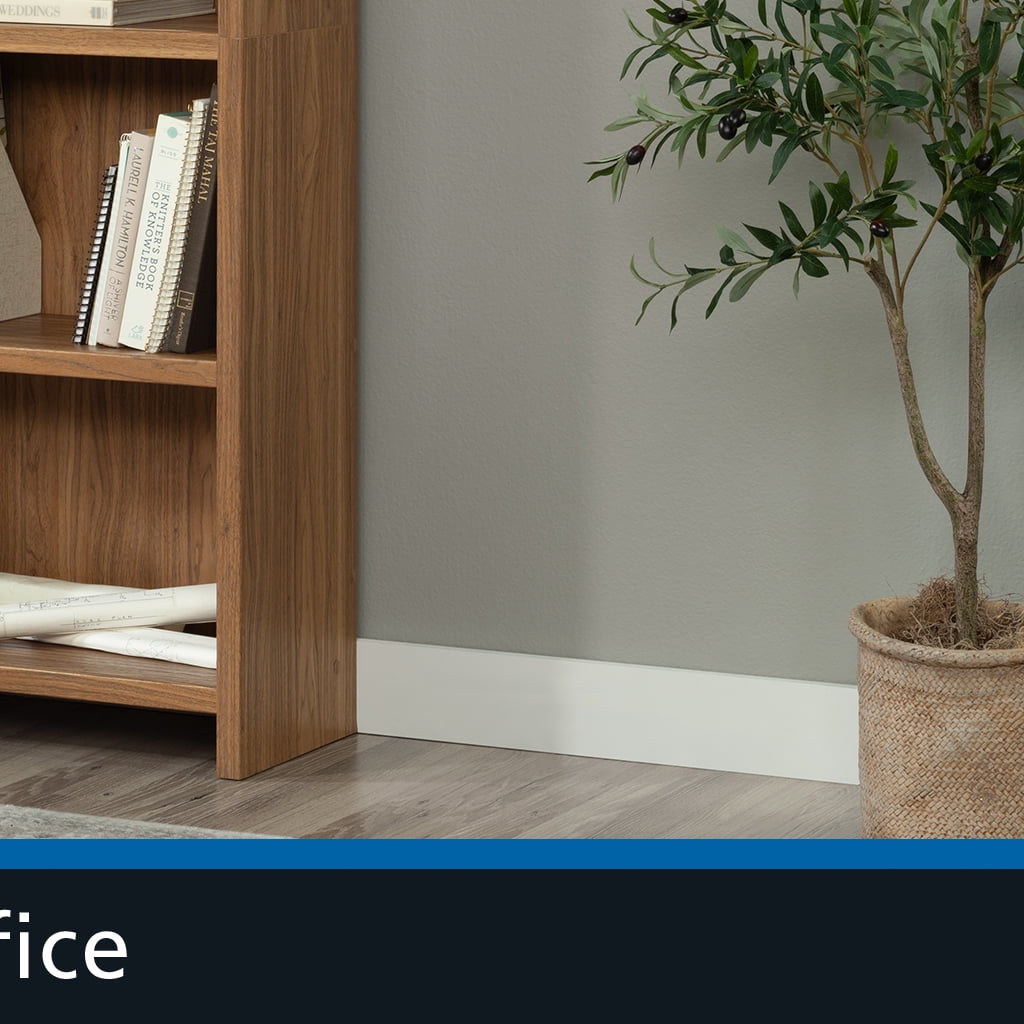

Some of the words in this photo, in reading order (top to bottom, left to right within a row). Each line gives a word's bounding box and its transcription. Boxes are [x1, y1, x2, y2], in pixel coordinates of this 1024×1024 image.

[205, 129, 218, 153] TAJ
[126, 146, 145, 194] LAURELL
[155, 181, 171, 191] THE
[197, 155, 215, 204] MAHAL
[151, 191, 160, 208] OF
[115, 209, 134, 268] HAMILTON
[151, 193, 170, 254] KNITTER'S
[135, 211, 157, 289] KNOWLEDGE
[108, 277, 117, 290] OF
[145, 258, 159, 291] BOOK
[104, 292, 114, 321] LIGHT
[110, 288, 122, 321] SHIVER
